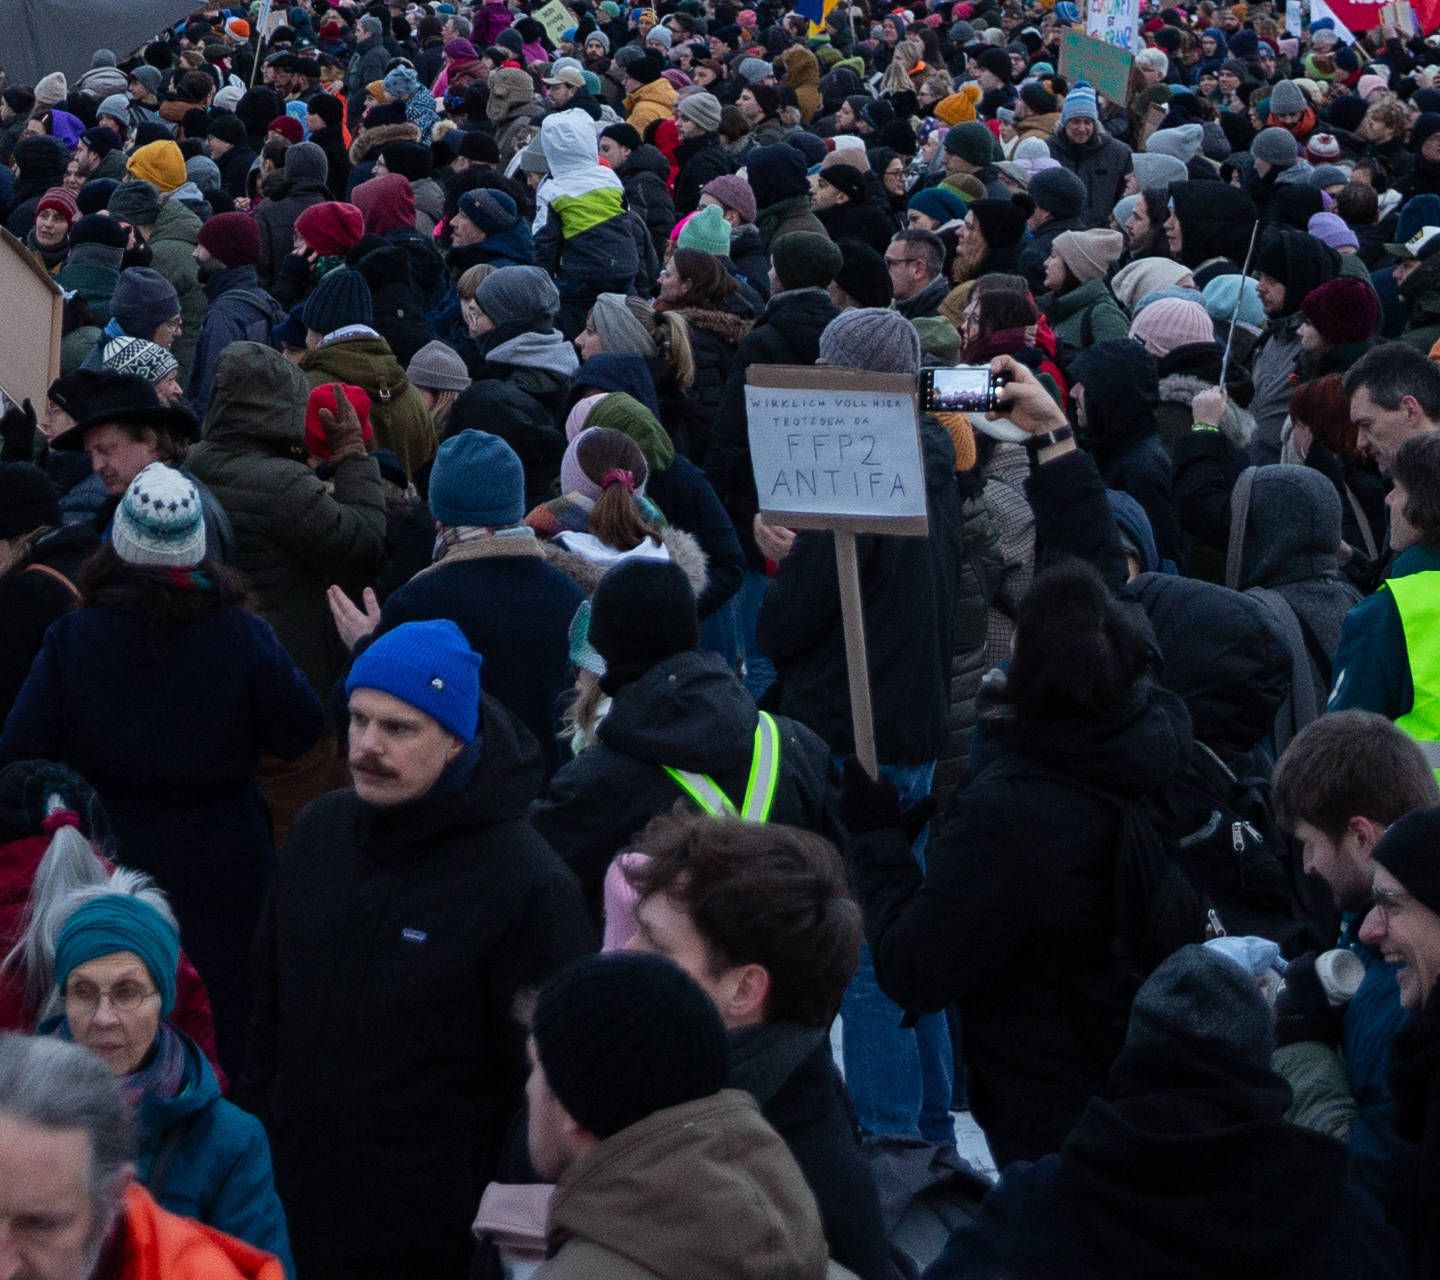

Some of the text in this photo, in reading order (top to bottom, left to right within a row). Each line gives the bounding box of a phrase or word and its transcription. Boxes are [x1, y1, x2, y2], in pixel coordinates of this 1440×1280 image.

[750, 398, 826, 409] WIRKLICH
[834, 399, 867, 408] VOLL
[787, 434, 881, 466] FFP2
[770, 469, 906, 499] ANTIFA
